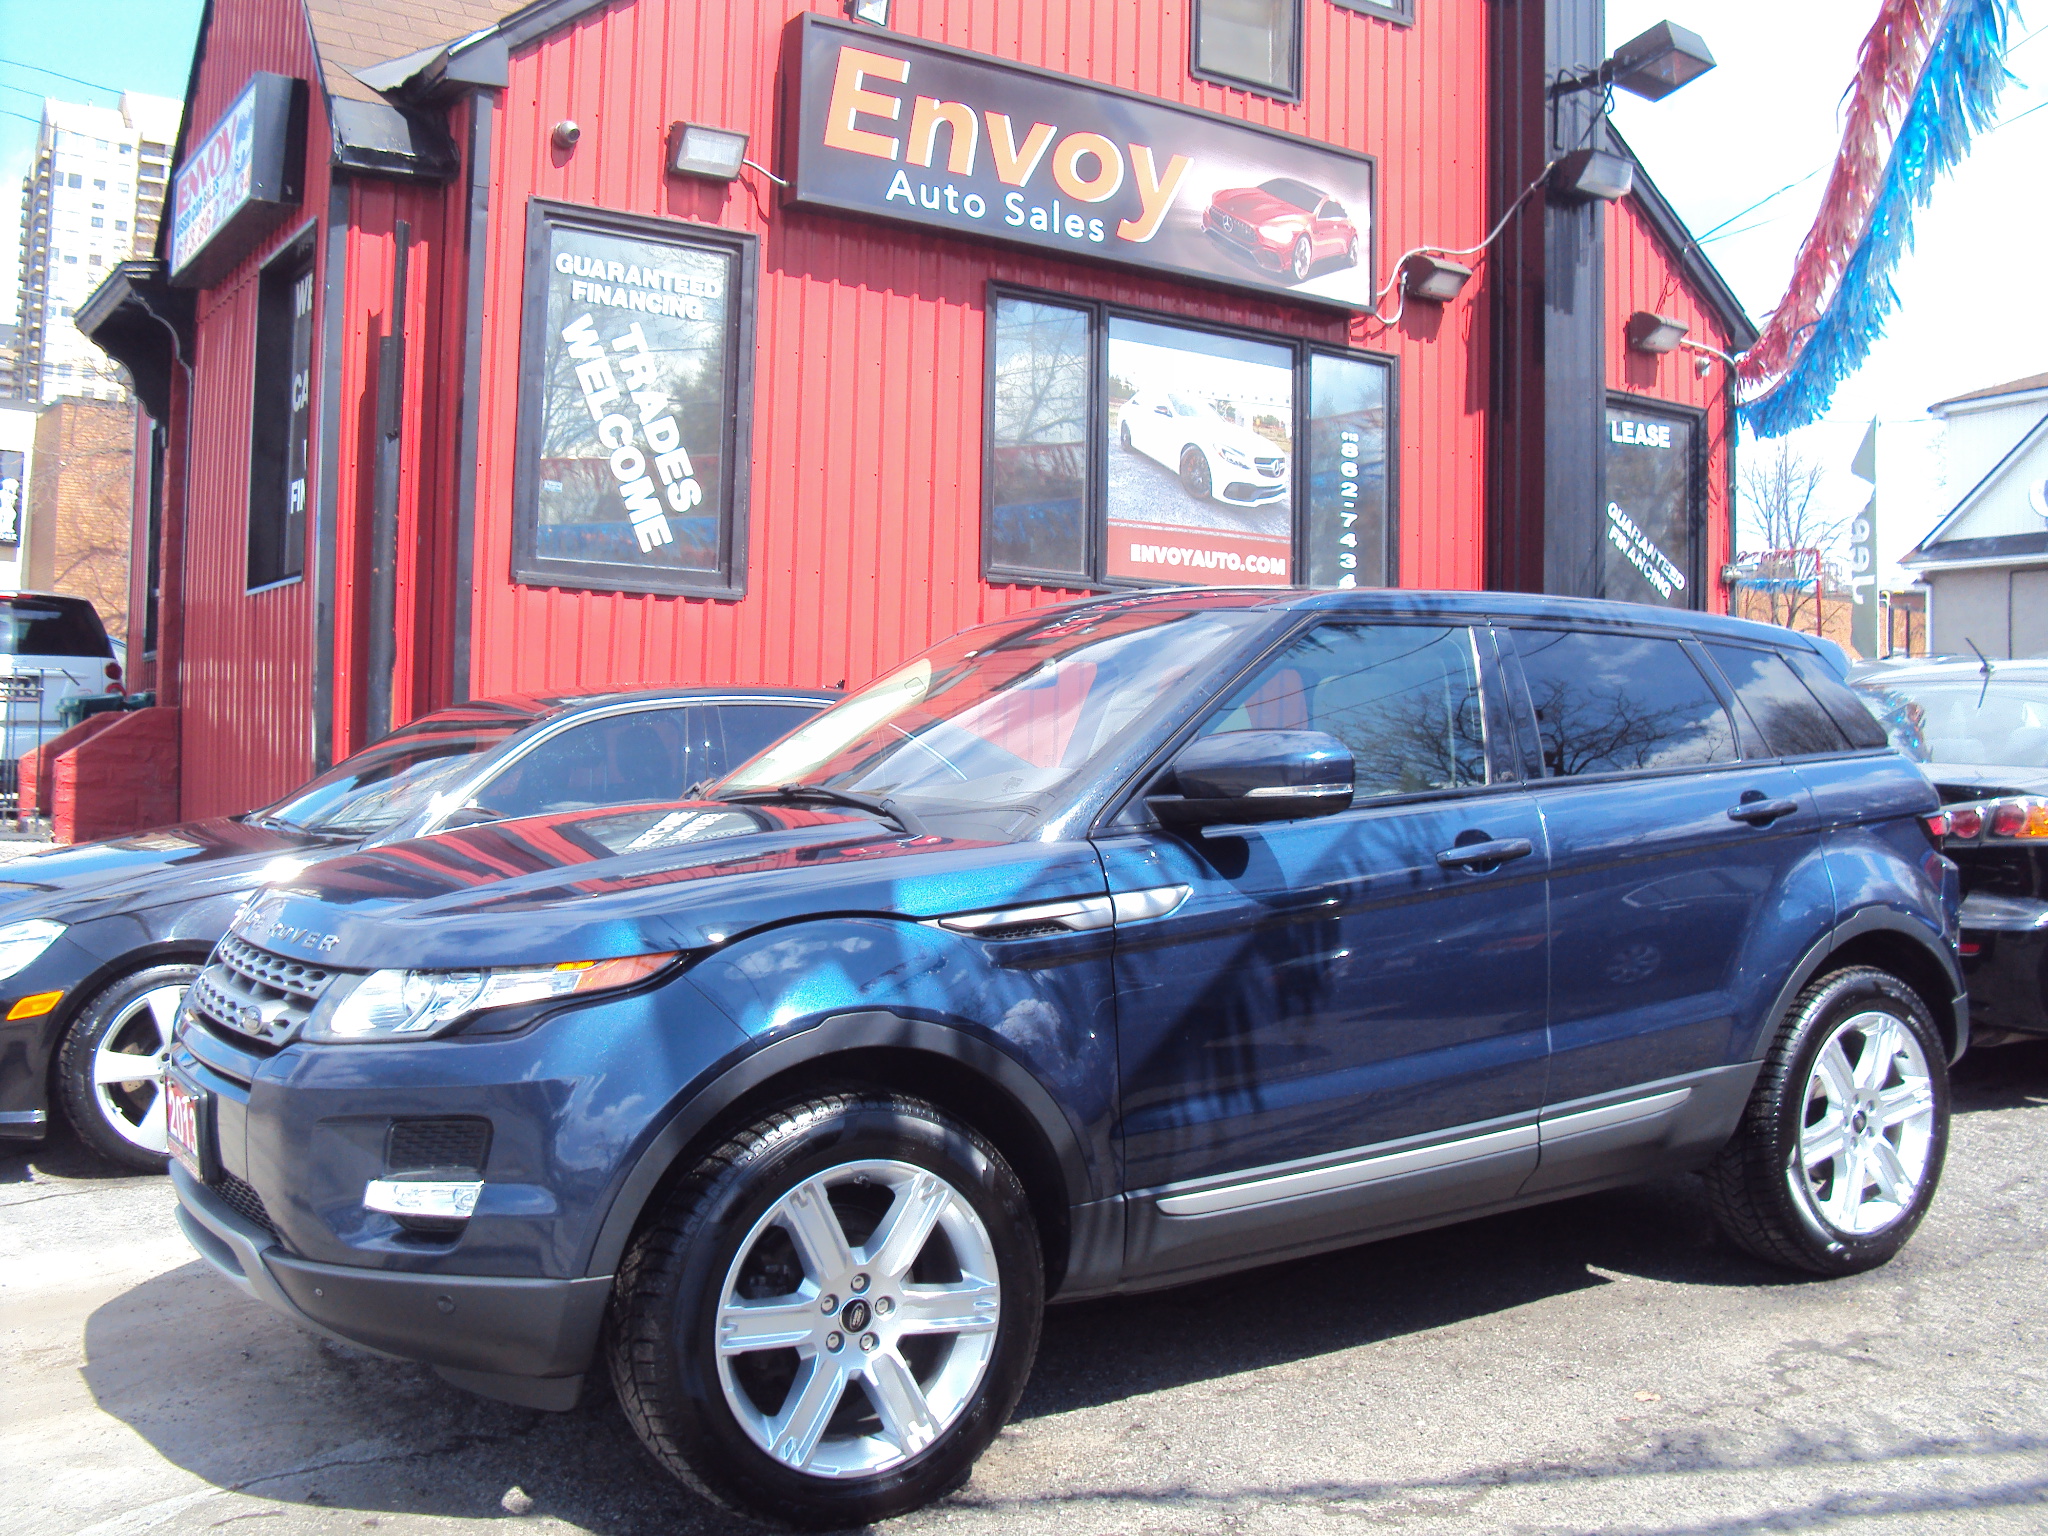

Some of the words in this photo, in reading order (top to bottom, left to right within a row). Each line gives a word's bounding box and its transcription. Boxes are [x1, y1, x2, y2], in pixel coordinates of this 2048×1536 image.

[177, 115, 238, 217] ENVOY
[823, 45, 1194, 243] Envoy
[886, 169, 986, 219] Auto
[1004, 191, 1105, 243] Sales
[555, 252, 723, 299] GUARANTEED
[571, 280, 704, 321] FINANCING
[561, 312, 674, 553] WELCOME
[611, 321, 702, 513] TRADES
[1611, 420, 1671, 449] LEASE
[1130, 543, 1286, 576] ENVOYAUTO.COM
[1607, 502, 1686, 590] GUARANTEED
[1608, 525, 1672, 599] FINANCING
[168, 1089, 198, 1157] 2013
